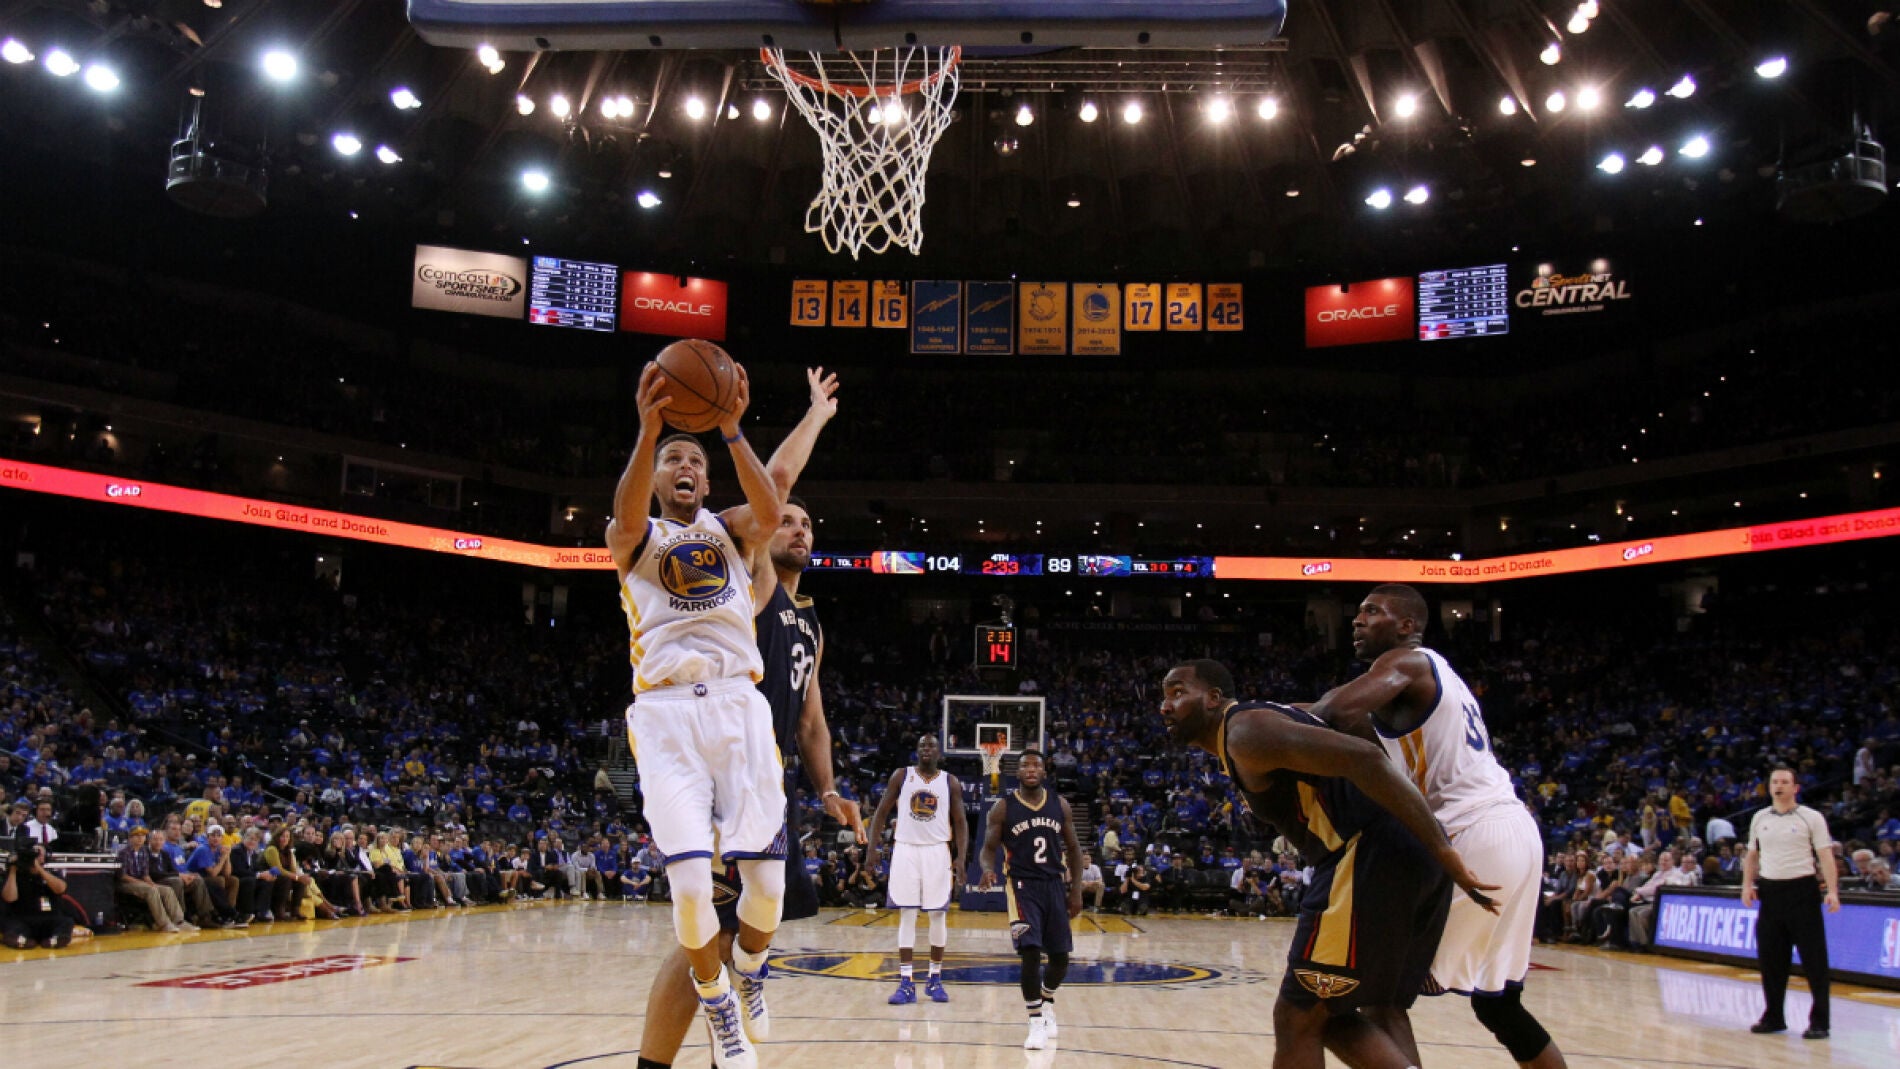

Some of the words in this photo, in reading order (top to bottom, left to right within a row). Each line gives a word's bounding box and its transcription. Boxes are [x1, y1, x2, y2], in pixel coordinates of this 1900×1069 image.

[1515, 280, 1632, 308] CENTRAL
[634, 297, 709, 316] ORACLE
[797, 297, 821, 320] 13
[838, 297, 861, 321] 14
[878, 298, 901, 321] 16
[1131, 302, 1153, 325] 17
[1169, 302, 1198, 324] 24
[1211, 302, 1240, 325] 42
[1317, 304, 1397, 322] ORACLE
[107, 484, 141, 497] GLAD
[242, 504, 271, 519] Join
[275, 509, 307, 524] Glad
[311, 516, 338, 529] and
[1743, 532, 1773, 545] Join
[1777, 526, 1814, 541] Glad
[1820, 521, 1849, 535] and
[1854, 517, 1900, 531] Dona
[456, 538, 481, 549] GLAD
[653, 533, 690, 560] GOLDEN
[695, 532, 726, 549] STATE
[1623, 544, 1653, 560] GLAD
[554, 552, 580, 563] Join
[583, 553, 612, 563] Glad
[690, 549, 716, 566] 30
[812, 558, 822, 566] TF
[837, 558, 852, 566] TOL
[926, 556, 960, 571] 104
[1048, 558, 1071, 572] 89
[1303, 562, 1331, 575] GLAD
[1420, 565, 1446, 576] Join
[1450, 565, 1480, 576] Glad
[1483, 562, 1505, 574] and
[669, 586, 736, 611] WARRIORS
[990, 644, 1009, 662] 14
[1011, 820, 1029, 836] NEW
[1033, 836, 1047, 864] 2
